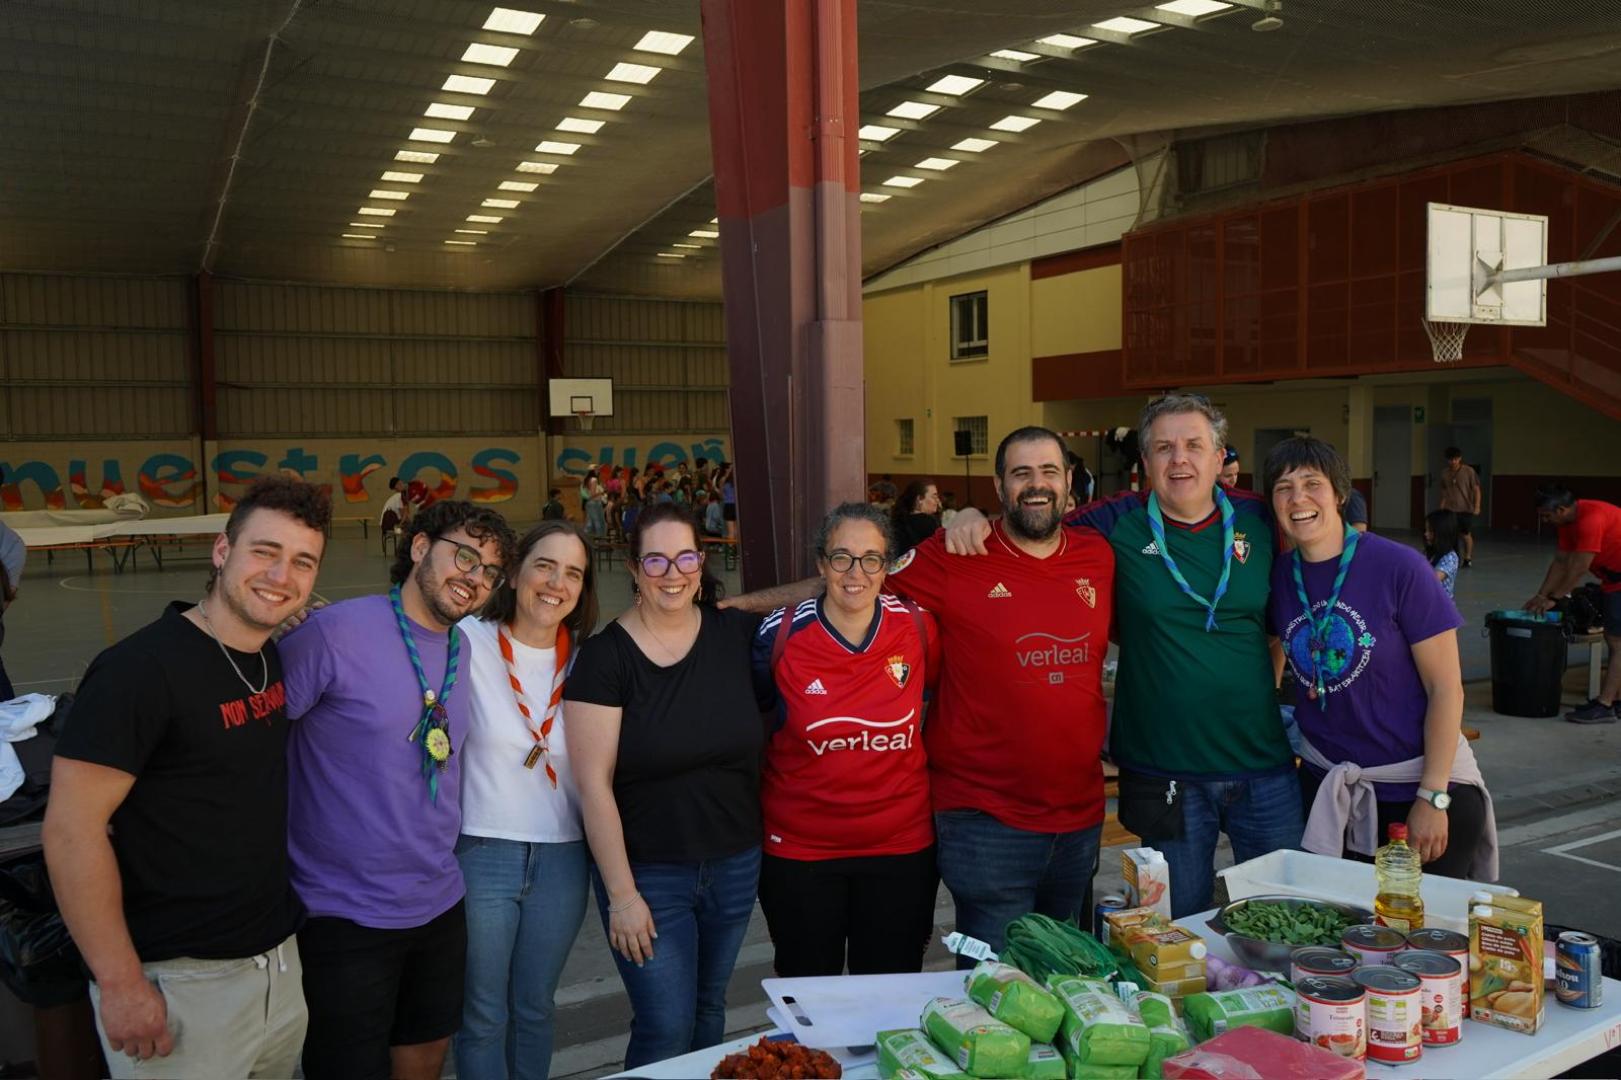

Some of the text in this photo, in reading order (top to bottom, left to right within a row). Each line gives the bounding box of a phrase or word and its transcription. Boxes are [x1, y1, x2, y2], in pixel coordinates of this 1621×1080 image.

[0, 447, 523, 512] nuestros
[1016, 642, 1089, 667] verleal
[219, 698, 248, 729] NON
[807, 724, 915, 756] verleal
